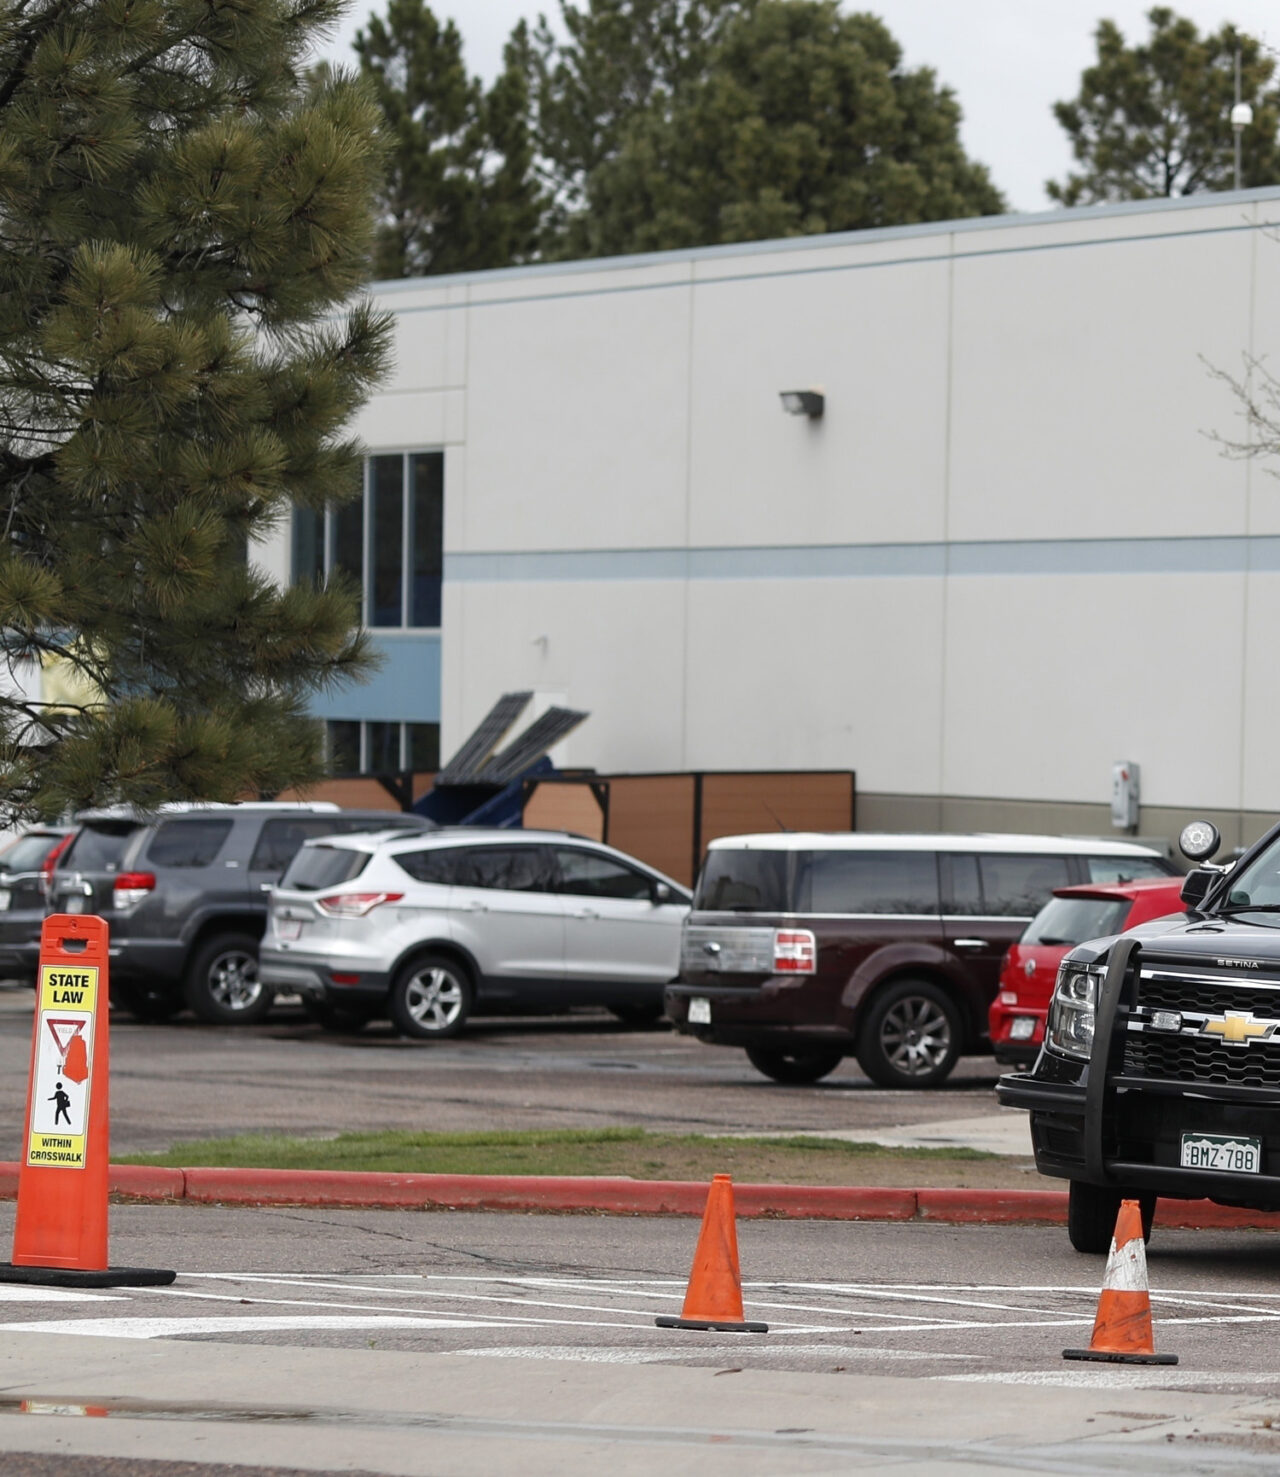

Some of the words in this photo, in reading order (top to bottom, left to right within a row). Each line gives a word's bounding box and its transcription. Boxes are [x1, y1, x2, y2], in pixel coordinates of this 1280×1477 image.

[1217, 960, 1259, 969] SETINA
[49, 974, 89, 987] STATE
[53, 990, 84, 1004] LAW
[41, 1138, 72, 1148] WITHIN
[30, 1150, 82, 1162] CROSSWALK
